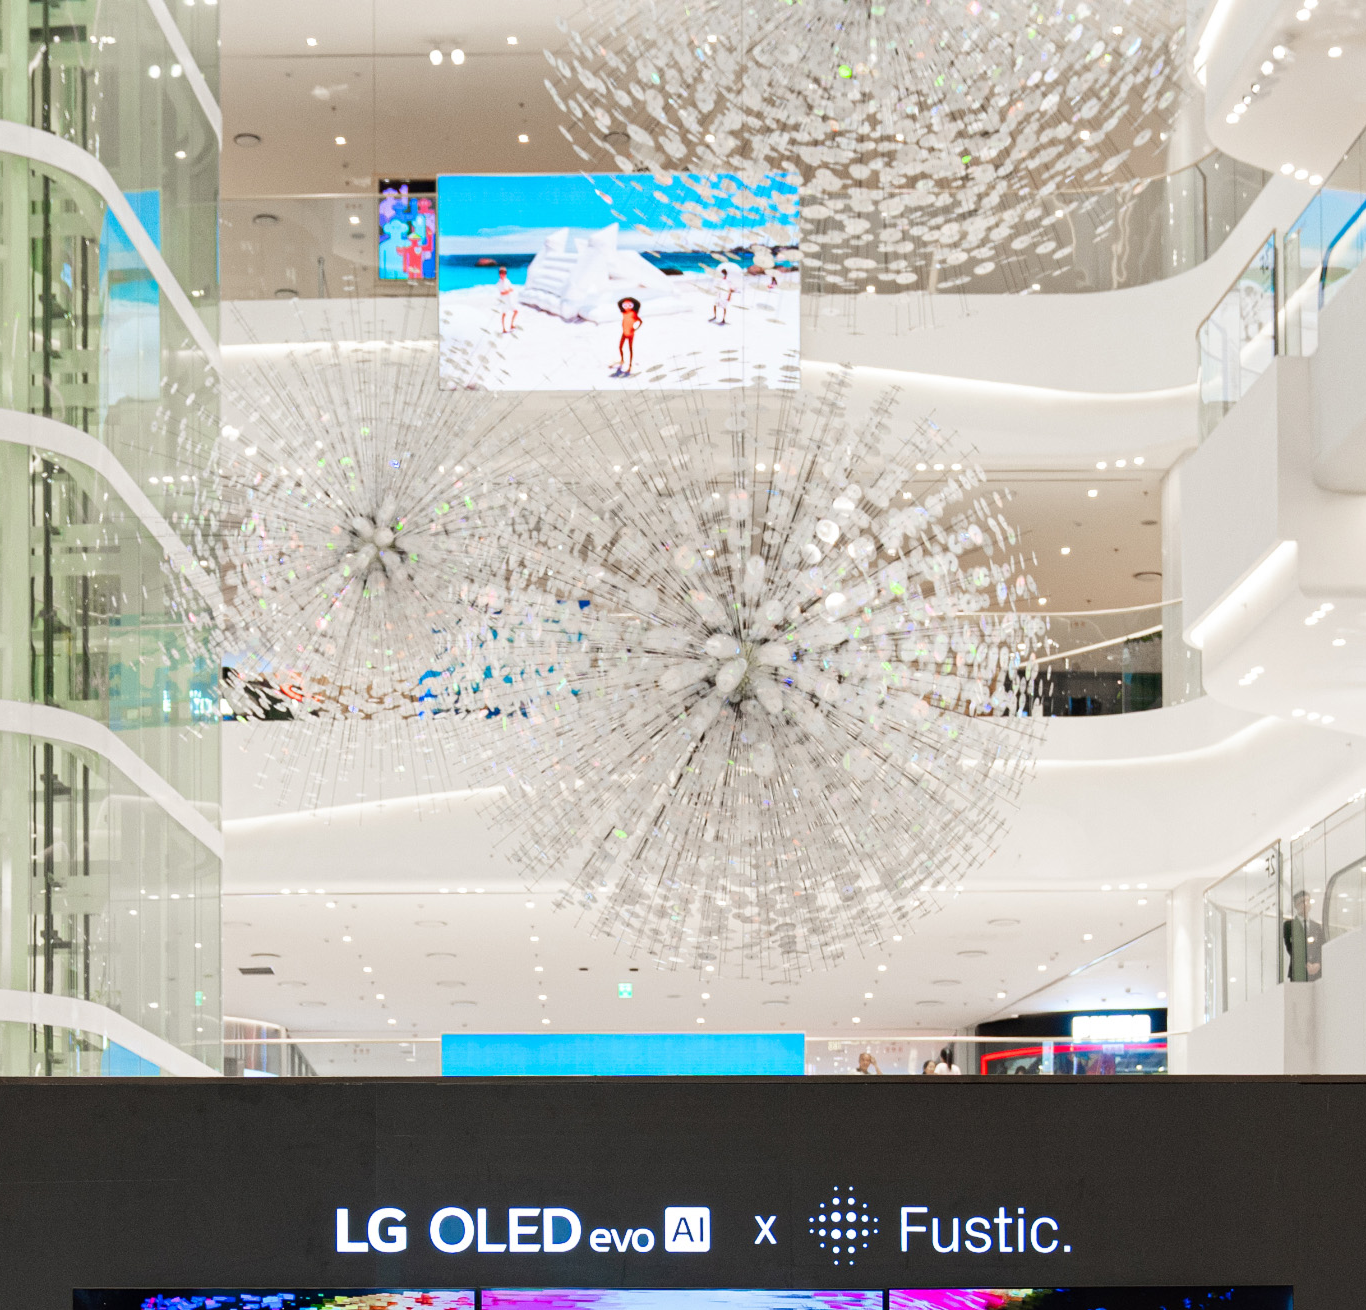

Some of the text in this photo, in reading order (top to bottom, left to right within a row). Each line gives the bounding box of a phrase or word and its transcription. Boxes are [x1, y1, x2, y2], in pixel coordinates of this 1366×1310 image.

[336, 1206, 408, 1254] LG
[429, 1205, 582, 1254] OLED
[589, 1227, 655, 1254] evo
[899, 1205, 1073, 1254] Fustic.
